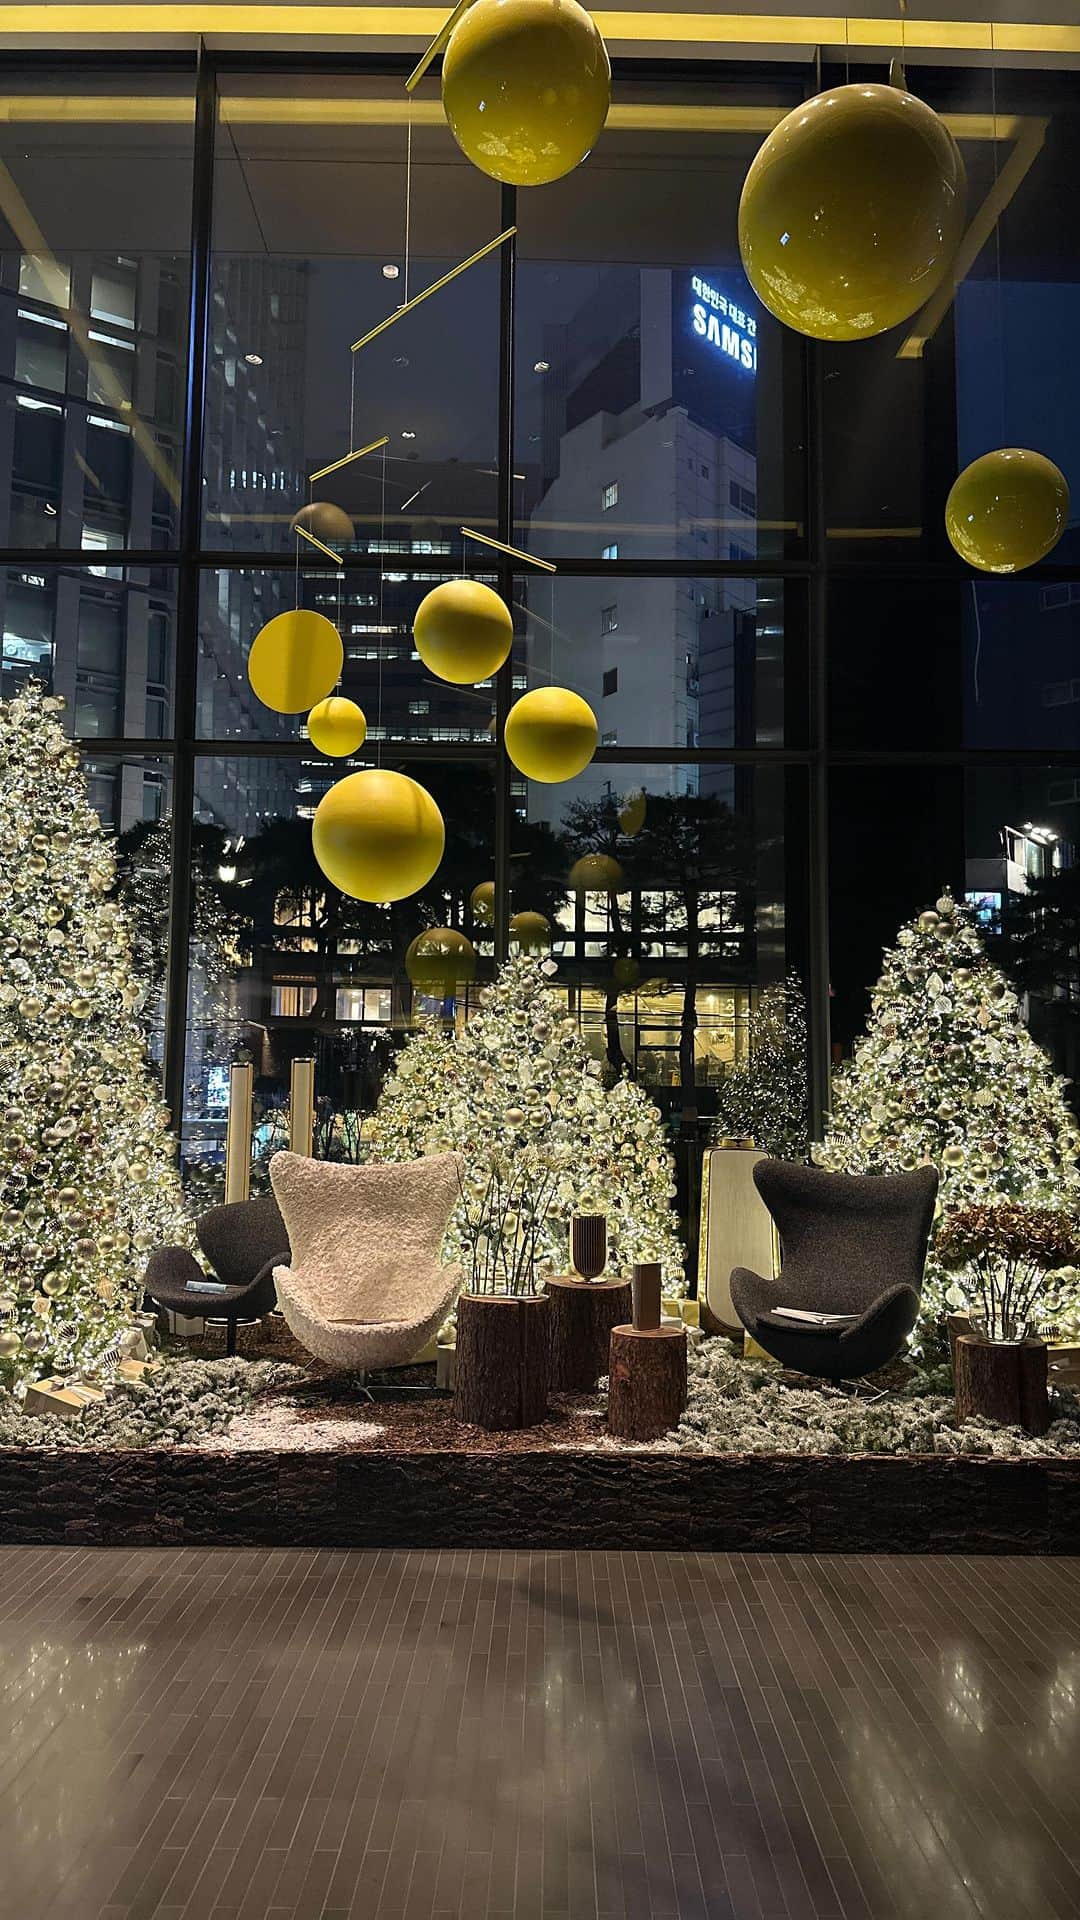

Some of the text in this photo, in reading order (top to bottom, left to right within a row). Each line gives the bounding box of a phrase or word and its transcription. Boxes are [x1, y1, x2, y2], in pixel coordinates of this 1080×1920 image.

[692, 276, 728, 315] 대한민국
[729, 304, 746, 328] 대표
[693, 303, 757, 371] SAMS
